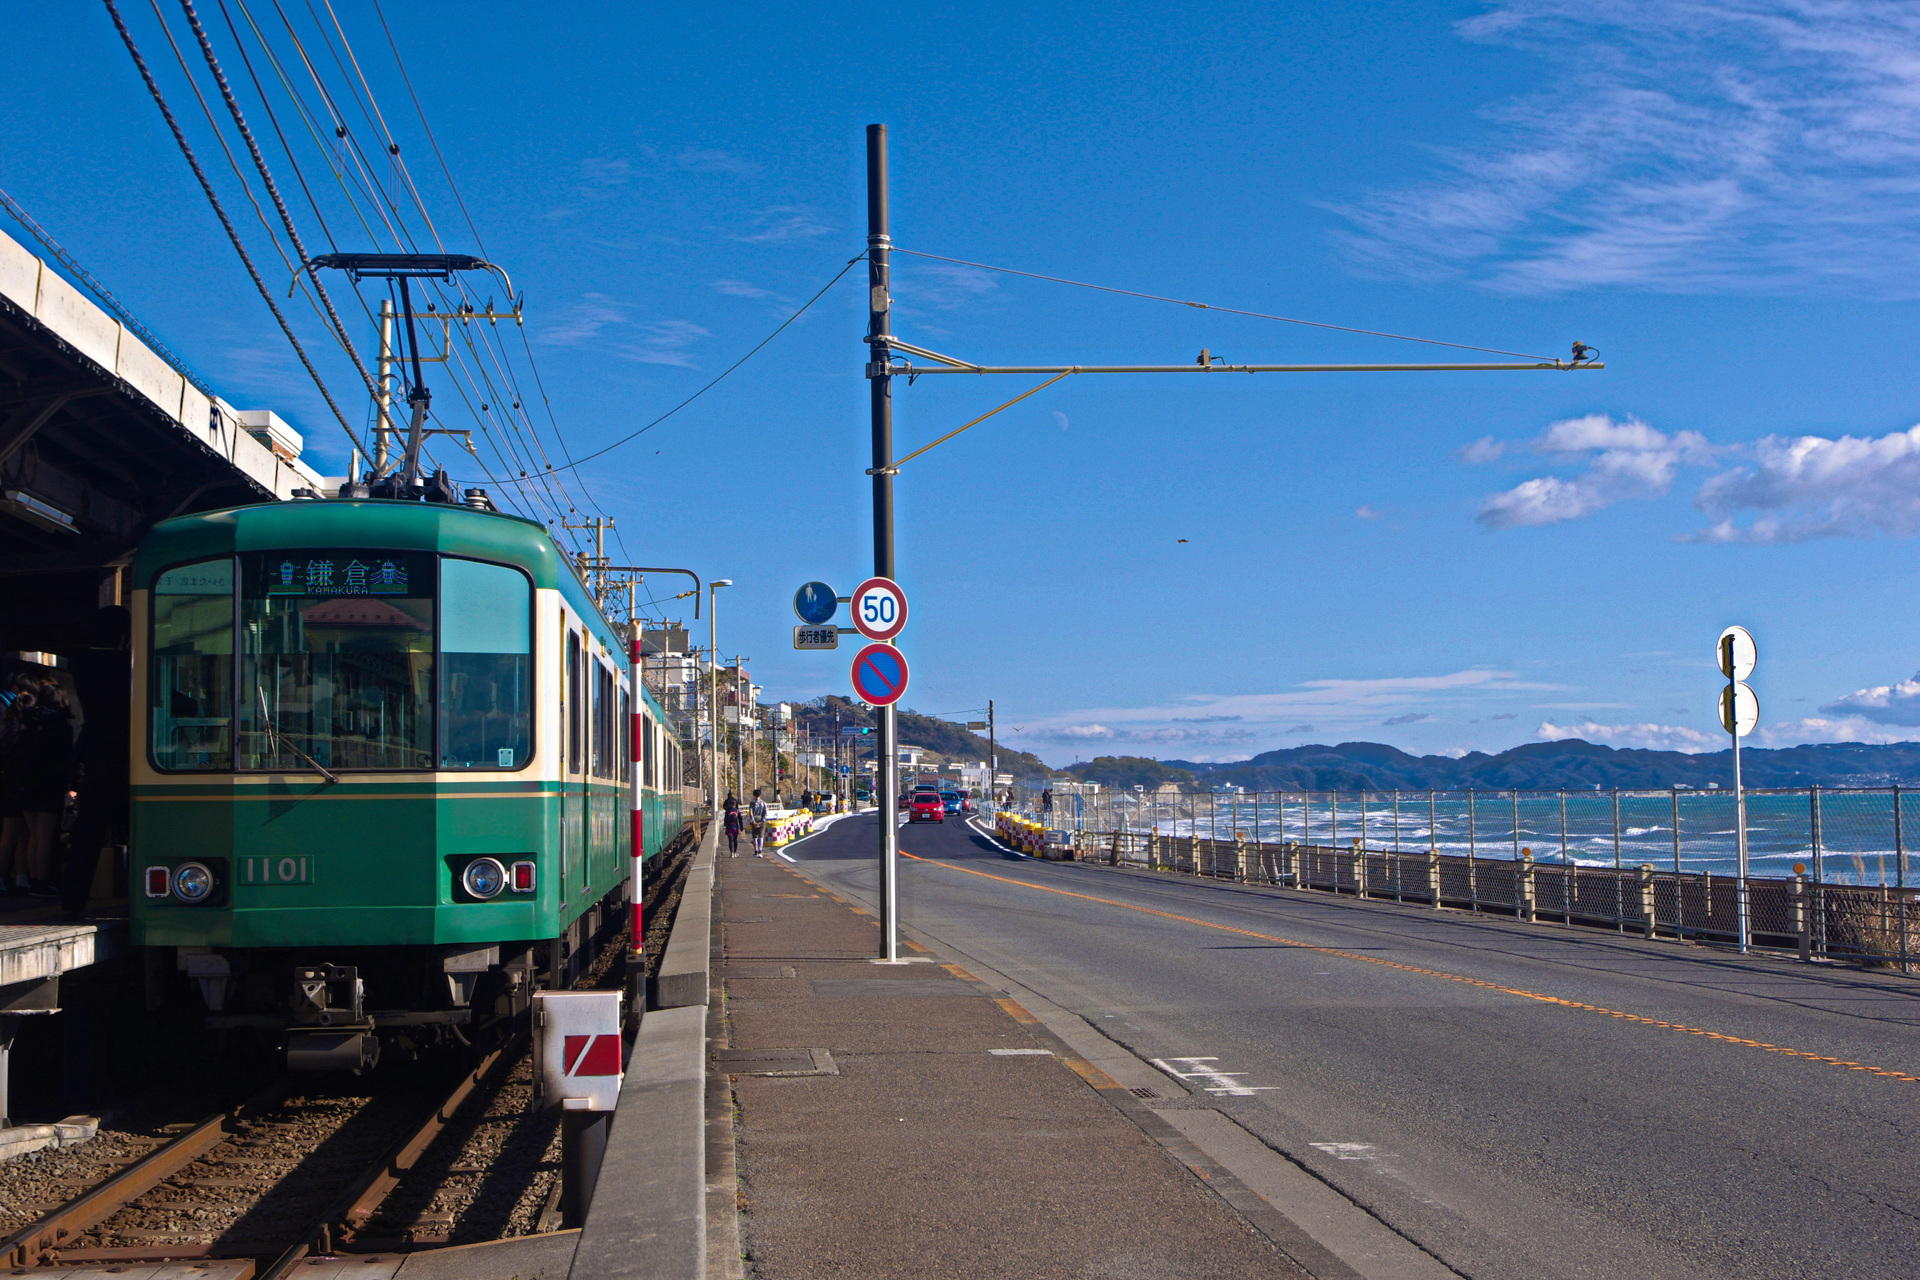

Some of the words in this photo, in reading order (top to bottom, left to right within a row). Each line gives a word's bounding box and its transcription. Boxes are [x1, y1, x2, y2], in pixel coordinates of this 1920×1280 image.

[306, 559, 369, 586] 鎌倉
[308, 586, 368, 595] KAMAKURA
[863, 595, 895, 623] 50
[798, 630, 835, 645] 歩行者優先
[247, 857, 306, 882] 1101
